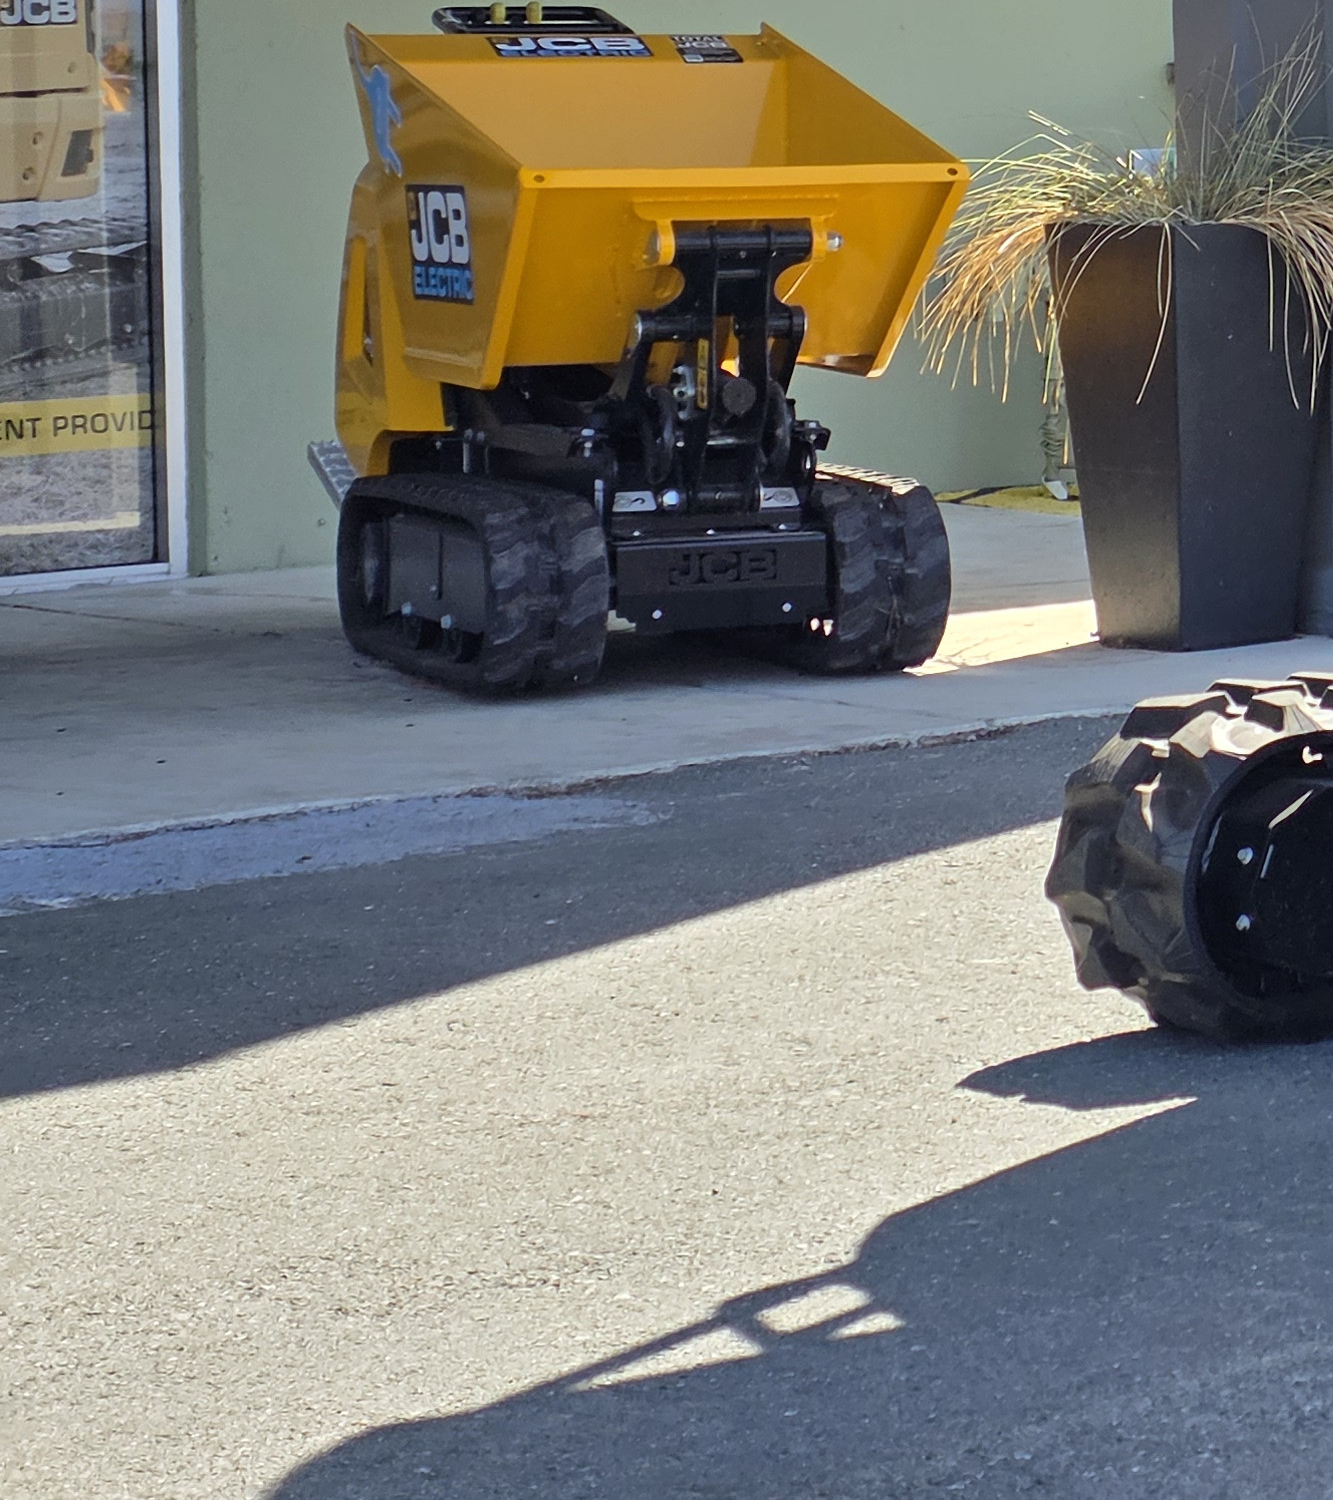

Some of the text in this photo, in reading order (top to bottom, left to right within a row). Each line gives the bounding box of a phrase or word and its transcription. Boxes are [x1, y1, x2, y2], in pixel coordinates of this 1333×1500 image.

[496, 37, 645, 50] JCB
[411, 191, 470, 265] JCB
[414, 266, 474, 299] ELECTRIC
